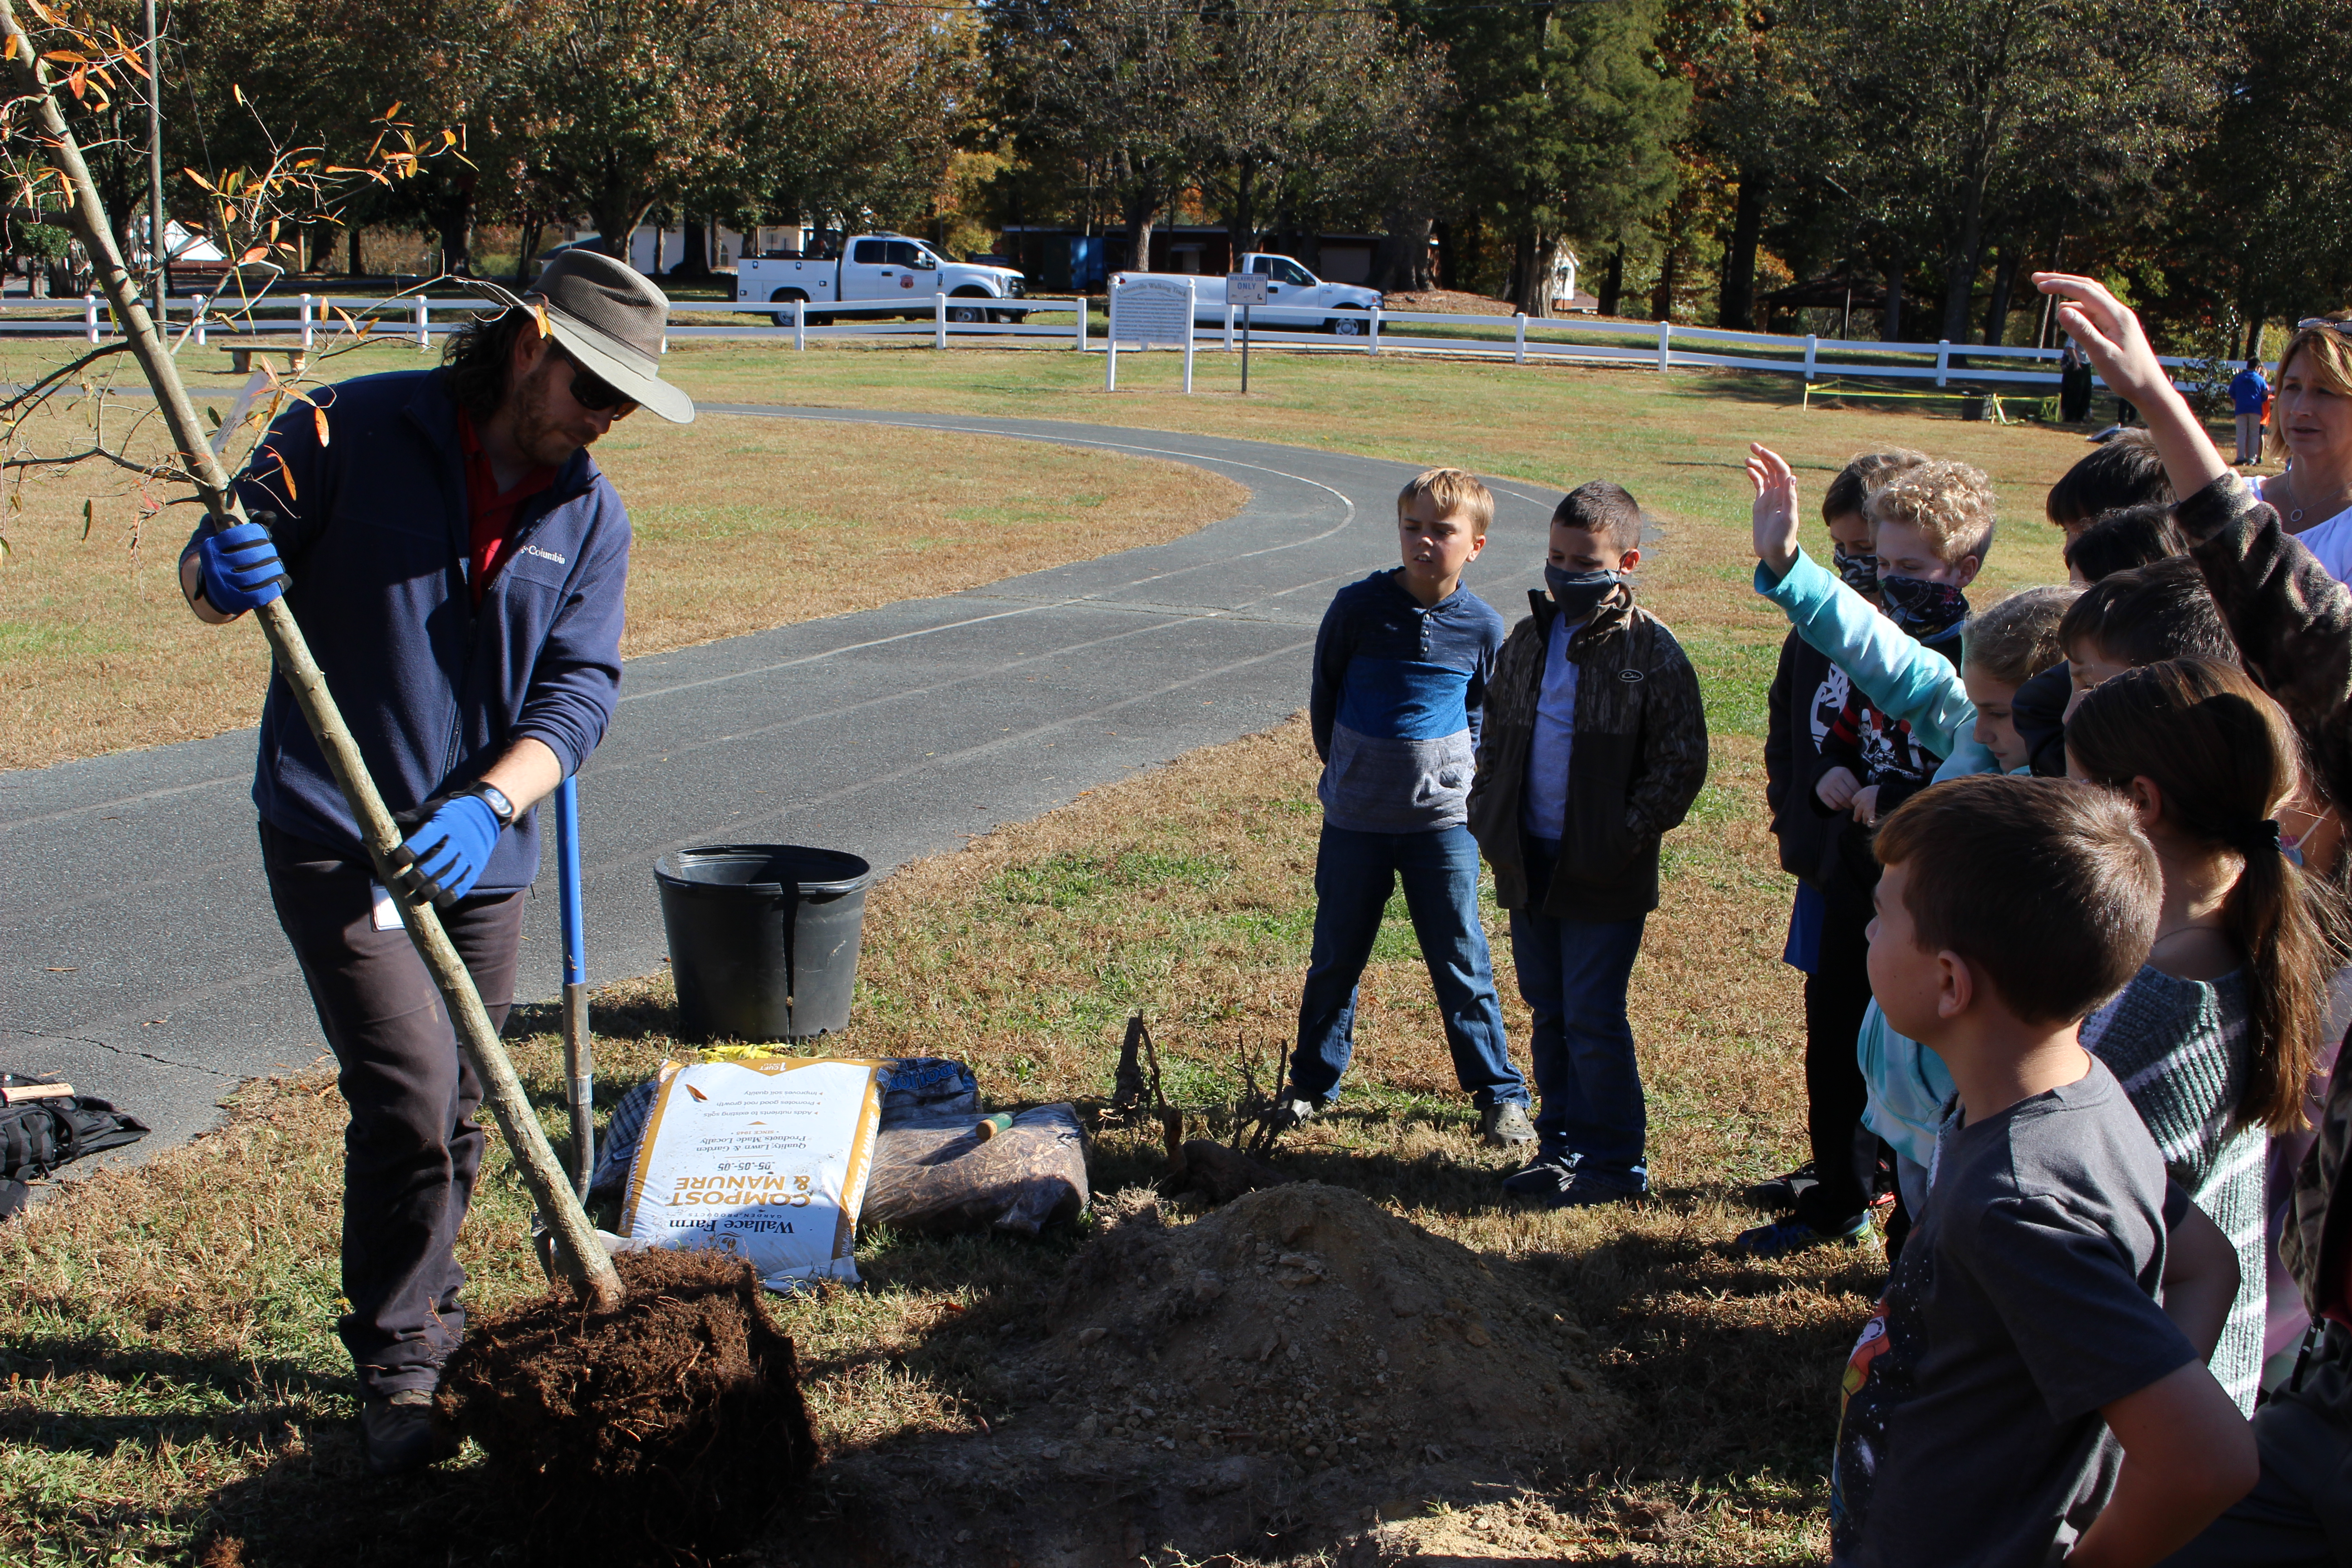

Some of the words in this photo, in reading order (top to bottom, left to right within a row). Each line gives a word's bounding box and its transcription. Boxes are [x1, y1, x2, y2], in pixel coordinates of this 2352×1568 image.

[1118, 283, 1147, 294] Unionville
[1148, 283, 1171, 293] Walking
[1173, 287, 1186, 296] Track
[529, 545, 566, 564] Columbia
[779, 1063, 786, 1071] 1
[862, 1111, 877, 1158] MANURE
[860, 1157, 873, 1169] &
[674, 1176, 785, 1191] MANURE
[793, 1175, 811, 1191] &
[665, 1191, 811, 1208] COMPOST
[669, 1219, 718, 1232] Farm
[724, 1219, 795, 1234] Wallace
